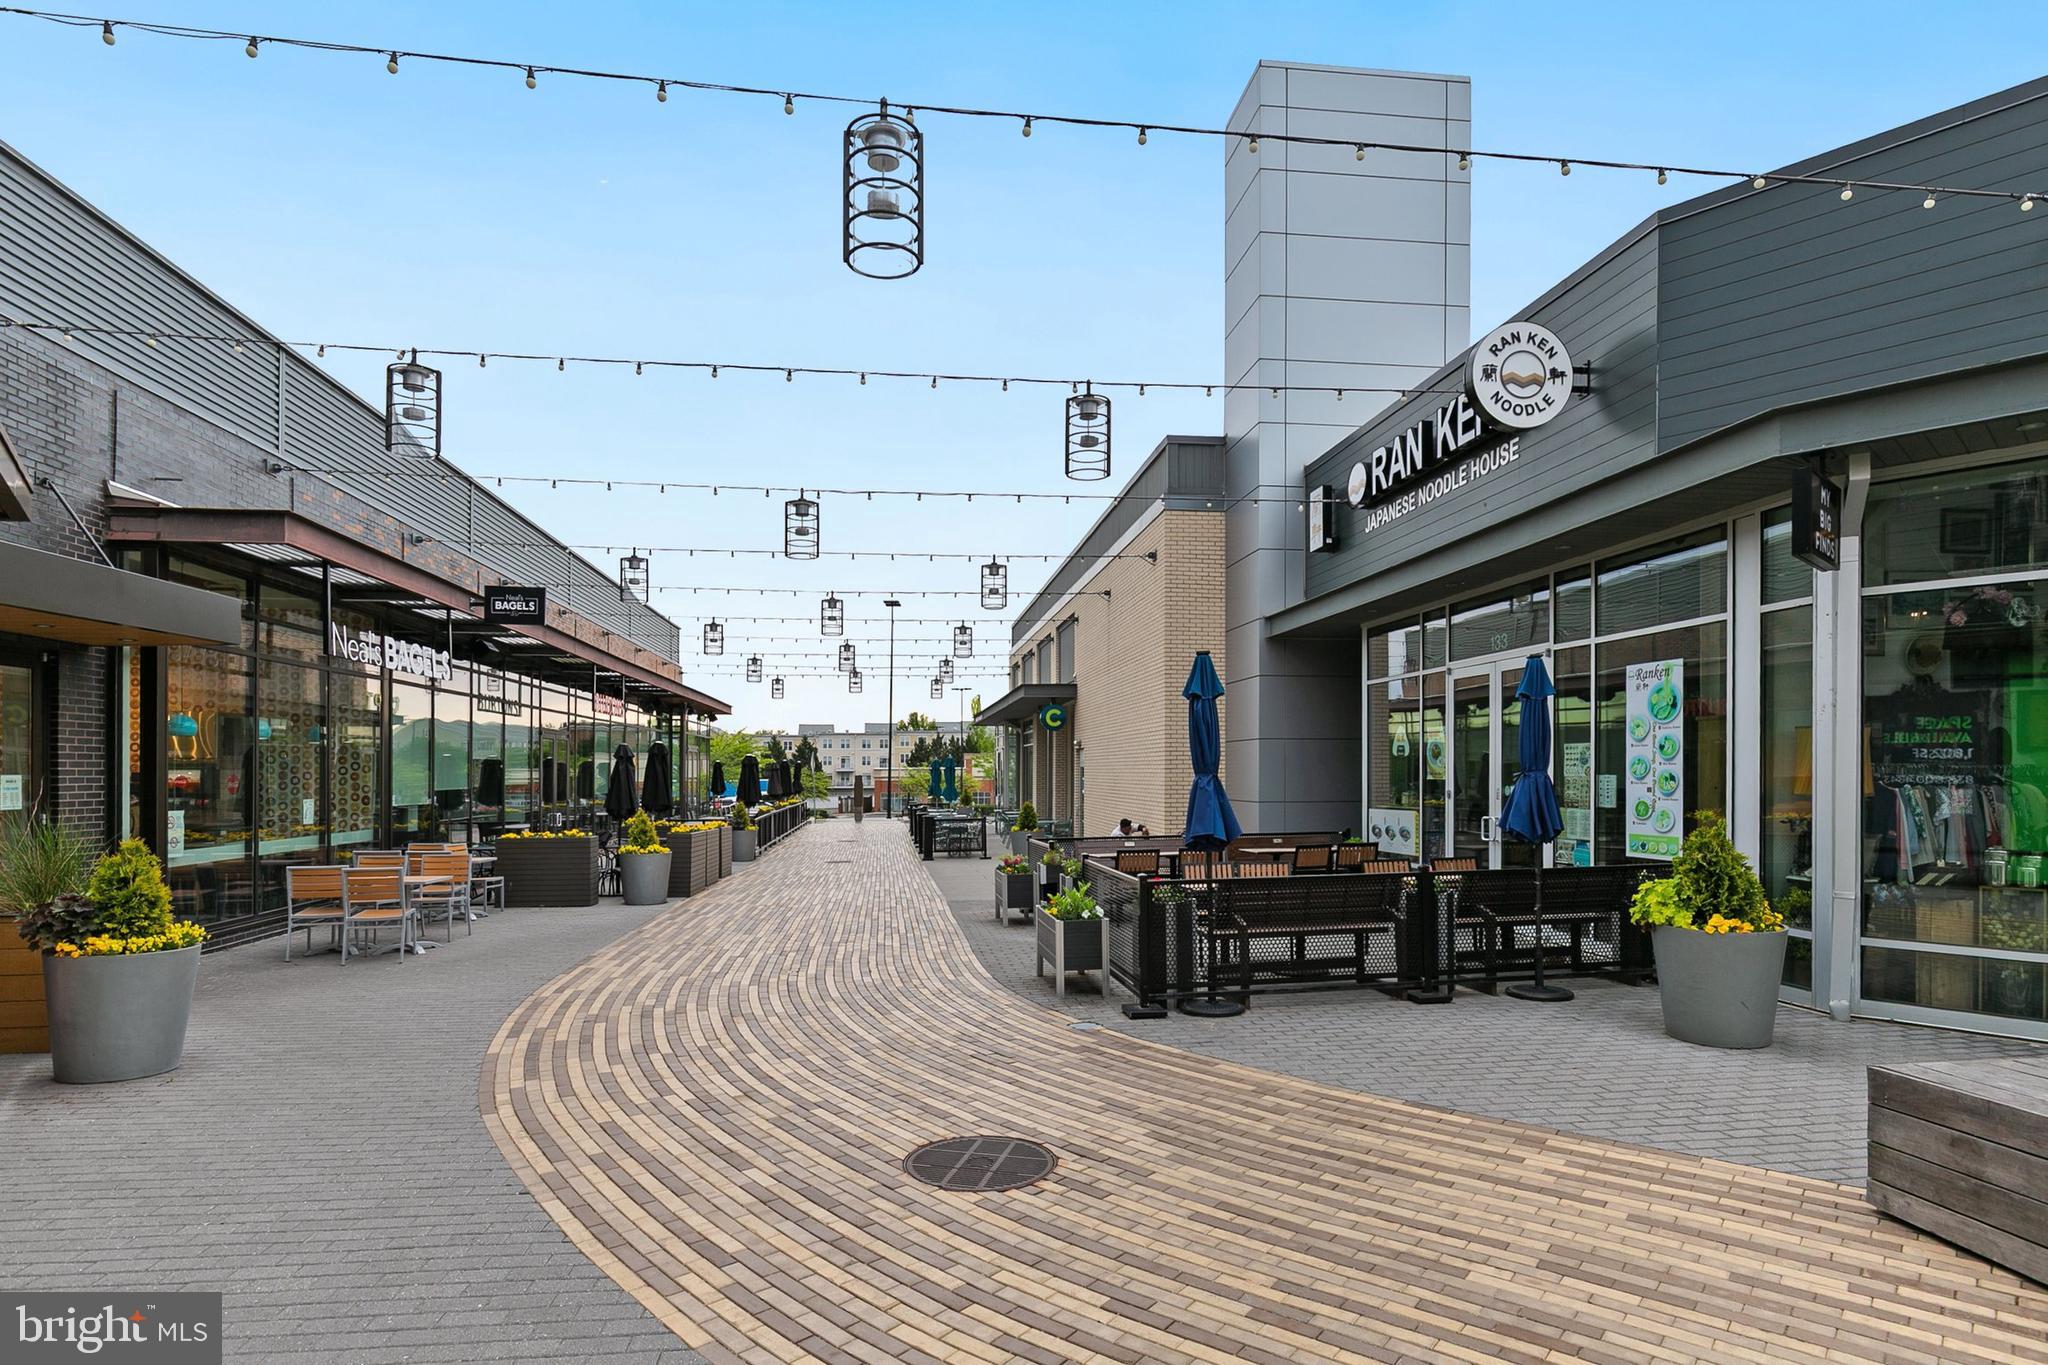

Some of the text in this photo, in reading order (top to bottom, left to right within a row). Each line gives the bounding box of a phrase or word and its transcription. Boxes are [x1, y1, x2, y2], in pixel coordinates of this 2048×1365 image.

[1488, 331, 1558, 360] RAN KEN
[1490, 390, 1556, 416] NOODLE
[1371, 393, 1482, 496] RAN KE
[1364, 491, 1416, 533] JAPANESE
[1417, 464, 1468, 507] NOODLE
[1470, 436, 1520, 481] HOUSE
[1820, 485, 1831, 508] MY
[1819, 508, 1833, 533] BIG
[1815, 530, 1836, 560] FINDS
[494, 601, 536, 611] BAGELS
[331, 620, 451, 681] Neal's BAGELS
[1491, 632, 1508, 652] 133
[1635, 664, 1671, 682] Ranken
[1045, 708, 1062, 727] C
